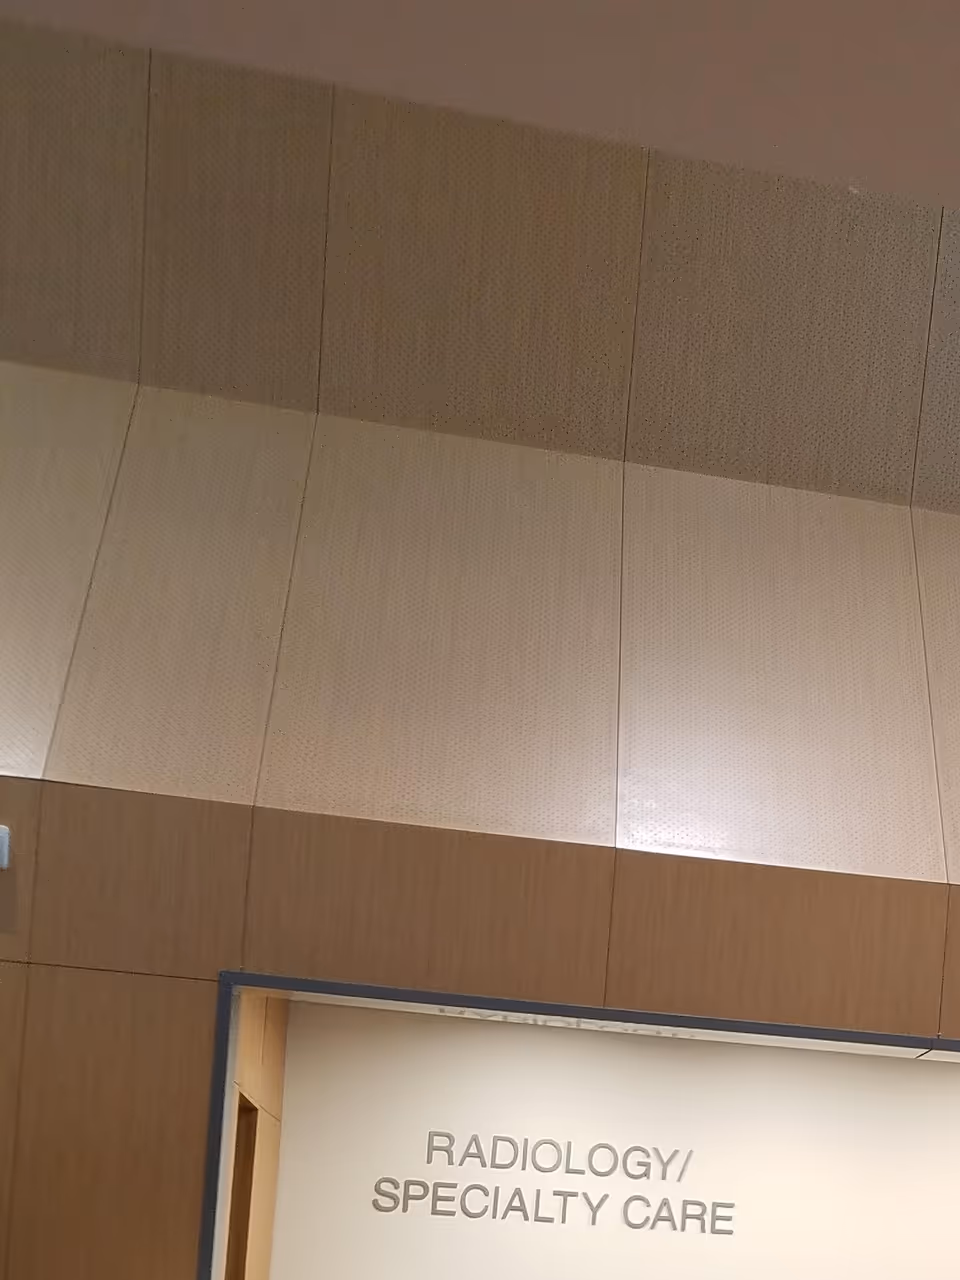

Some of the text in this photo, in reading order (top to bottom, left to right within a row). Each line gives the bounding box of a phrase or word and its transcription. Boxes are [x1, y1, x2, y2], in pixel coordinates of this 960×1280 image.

[425, 1130, 693, 1182] RADIOLOGY/
[371, 1177, 735, 1235] SPECIALTY CARE
